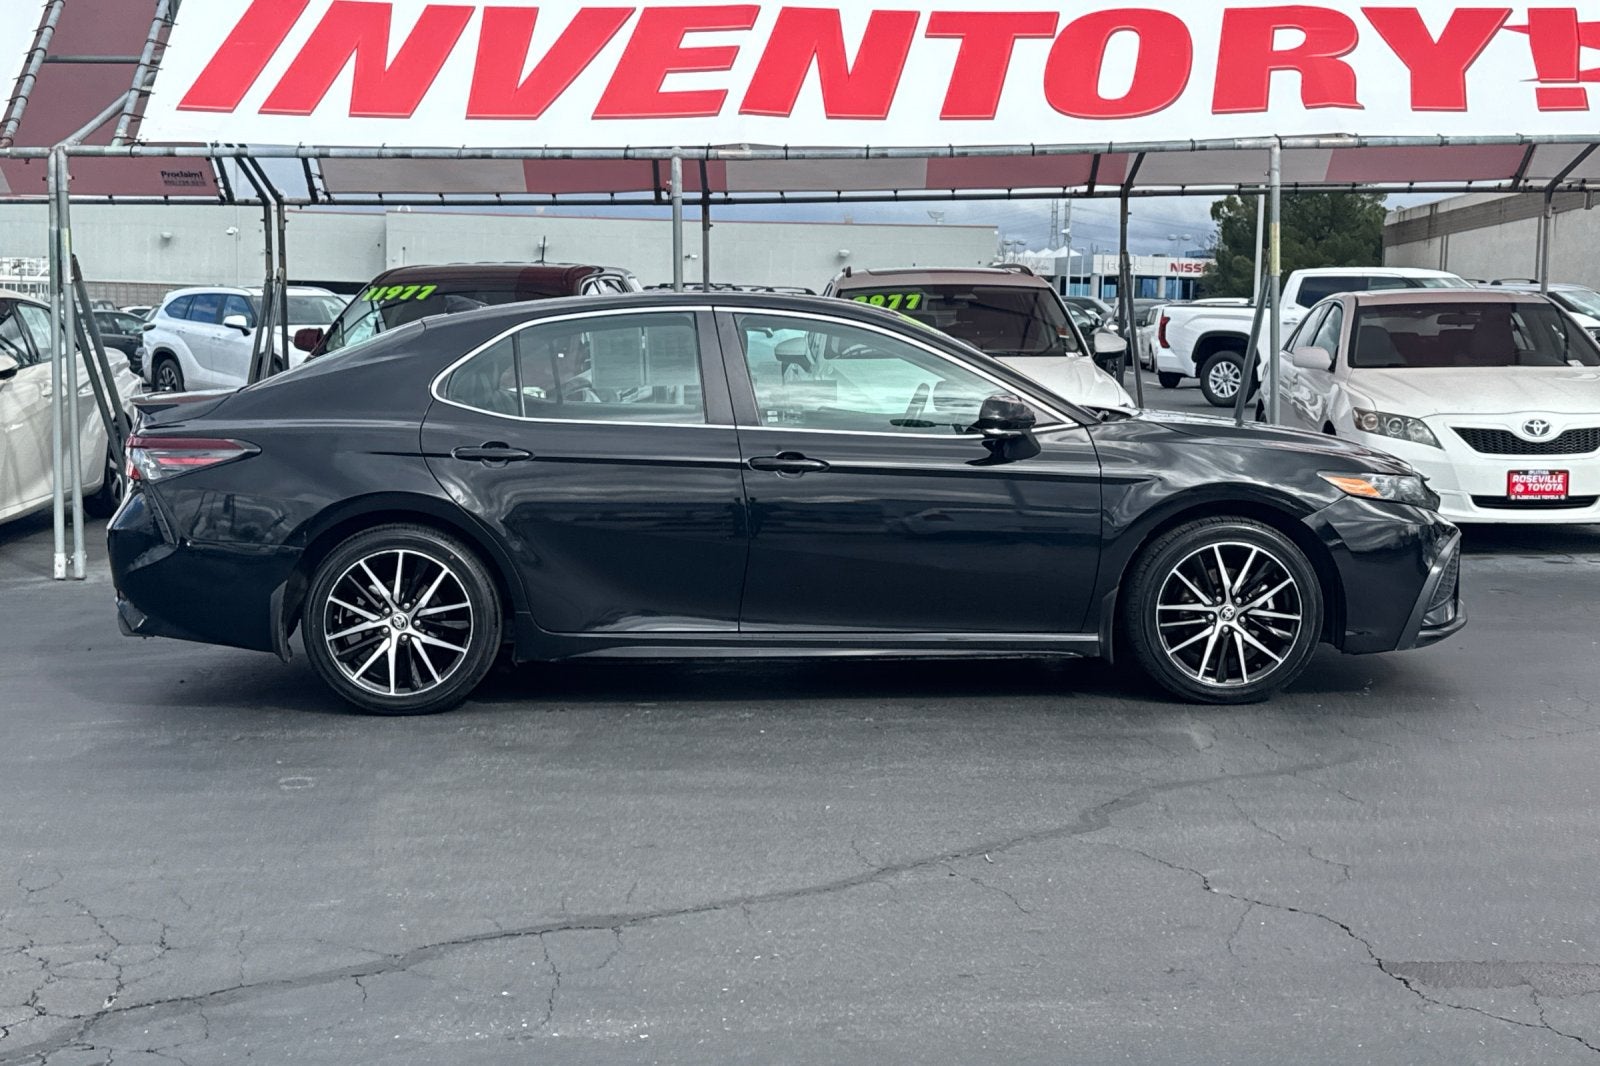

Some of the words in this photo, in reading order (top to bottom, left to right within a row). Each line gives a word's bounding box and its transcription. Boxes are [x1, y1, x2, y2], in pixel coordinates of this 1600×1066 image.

[176, 0, 1590, 120] INVENTORY!
[1170, 262, 1202, 273] NISS
[1512, 475, 1564, 483] ROSEVILLE
[1527, 483, 1564, 491] TOYOTA
